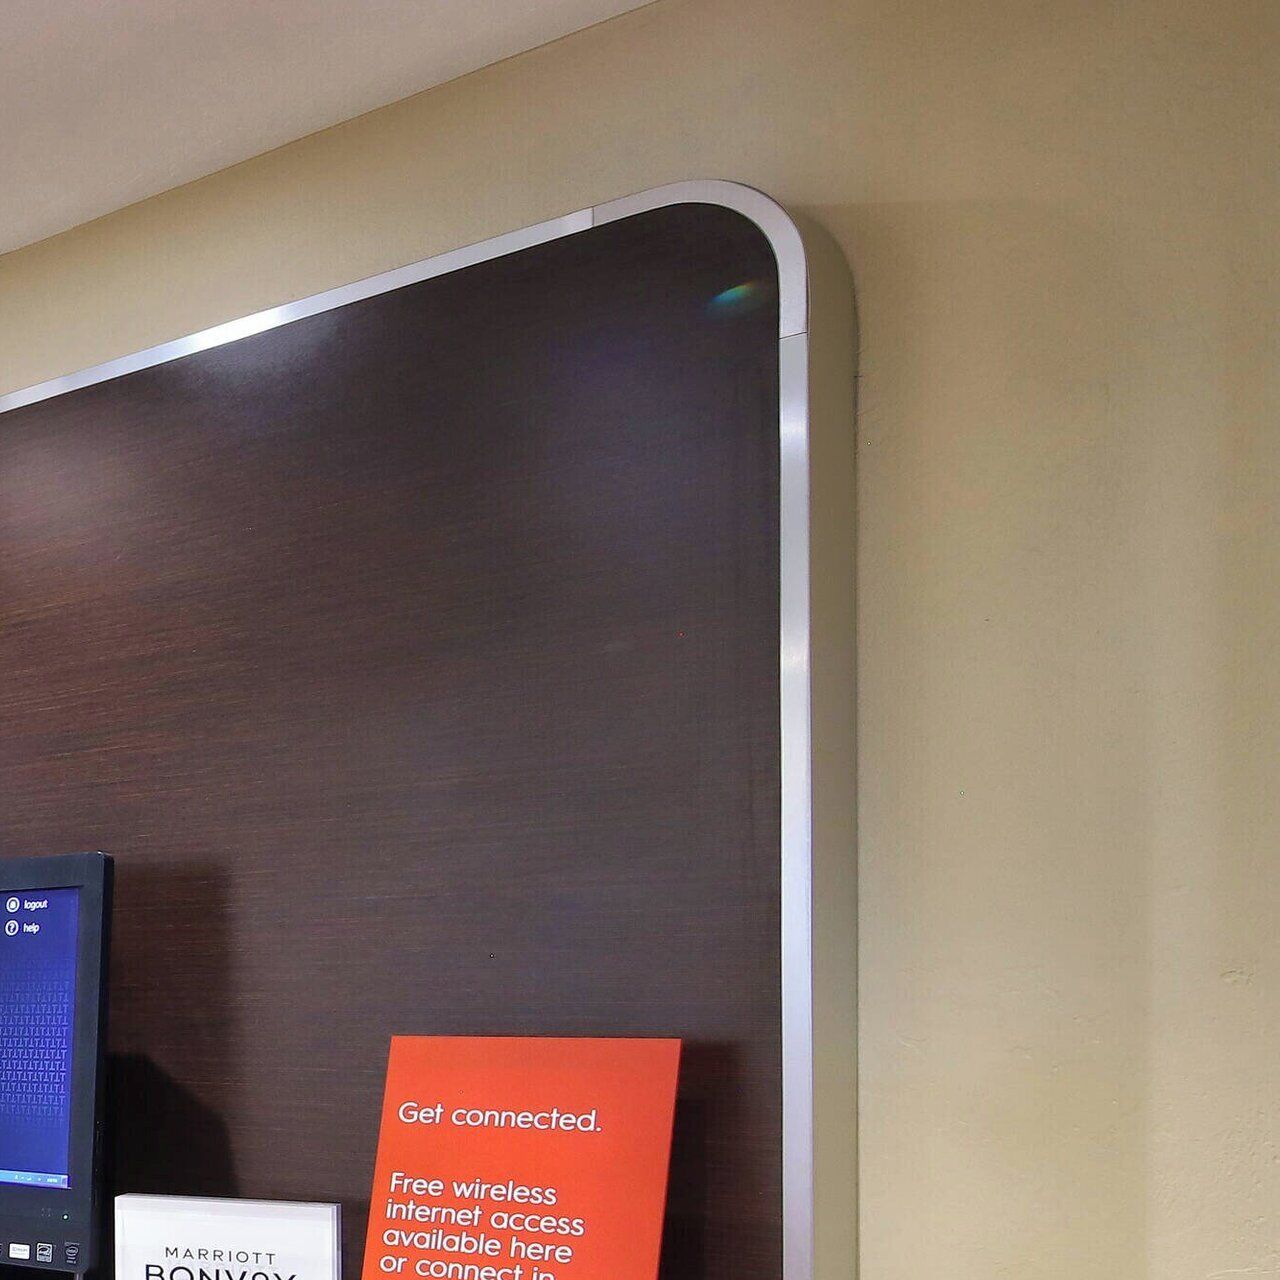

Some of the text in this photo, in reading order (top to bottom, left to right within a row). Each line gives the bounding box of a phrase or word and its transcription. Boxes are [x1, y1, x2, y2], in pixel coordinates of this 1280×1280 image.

[24, 899, 48, 911] logout
[23, 923, 40, 934] help
[398, 1101, 602, 1132] Get connected.
[390, 1171, 557, 1206] Free wireless
[386, 1199, 586, 1236] internet access
[165, 1247, 276, 1265] MARRIOTT
[382, 1229, 573, 1264] available here
[379, 1255, 407, 1273] or
